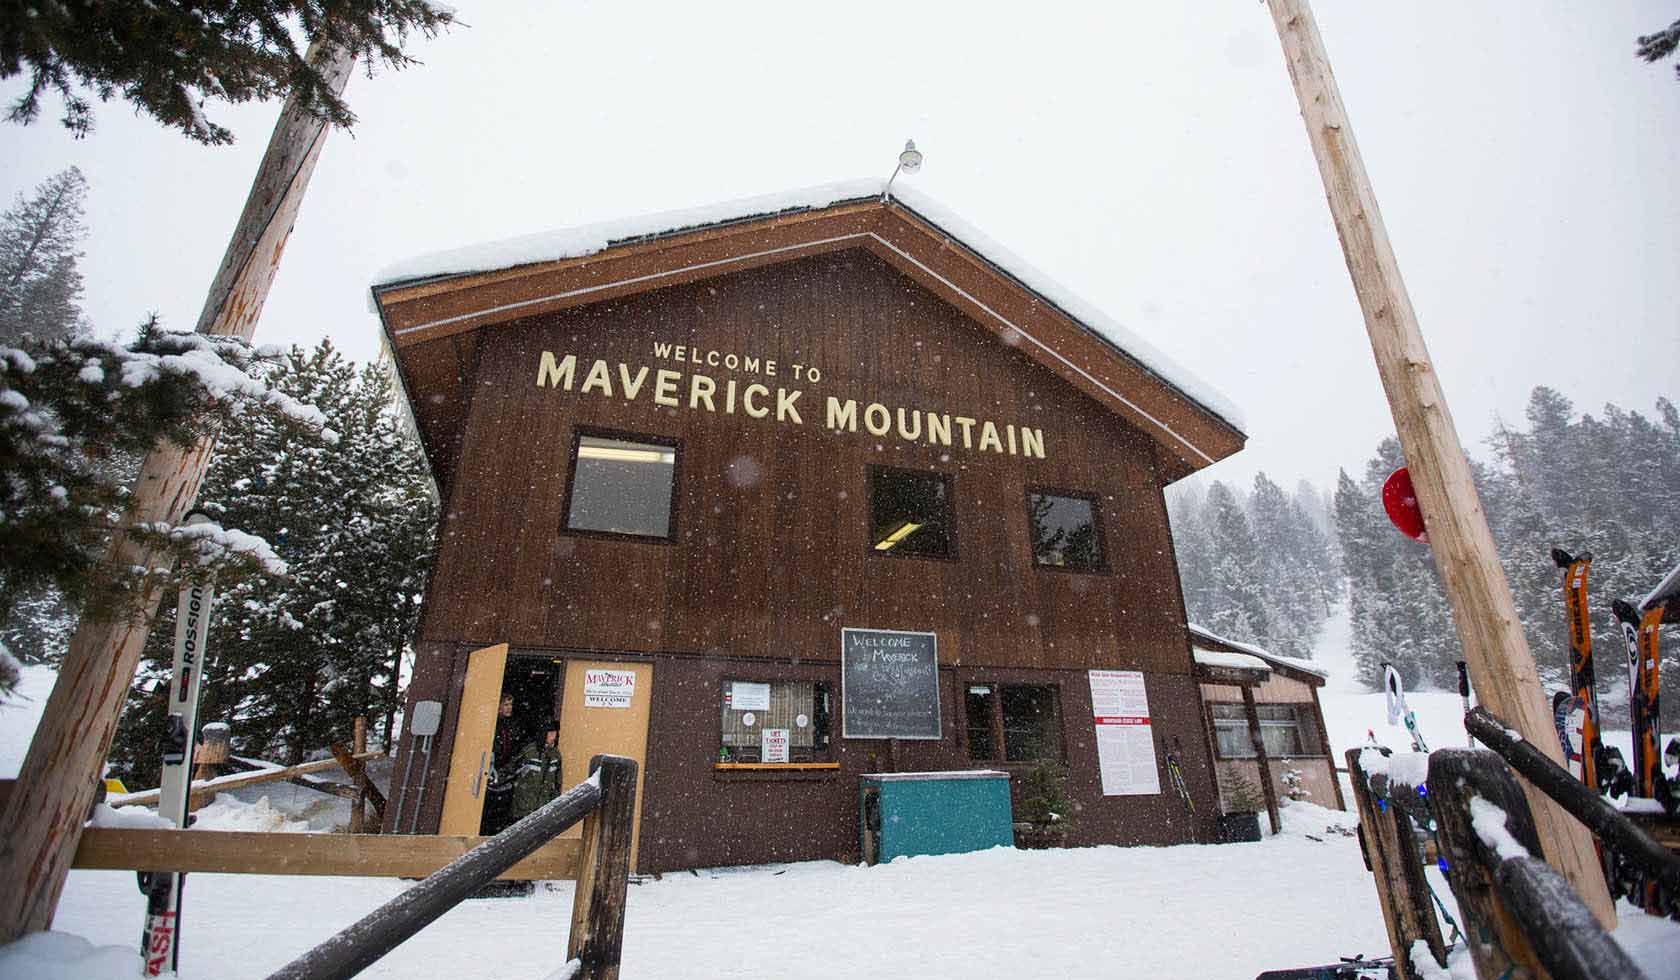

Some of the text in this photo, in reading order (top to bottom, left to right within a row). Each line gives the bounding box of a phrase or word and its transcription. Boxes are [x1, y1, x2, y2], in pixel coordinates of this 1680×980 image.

[653, 342, 821, 383] WELCOME TO
[536, 350, 1046, 459] MAVERICK MOUNTAIN
[183, 582, 204, 664] ROSSIGN
[586, 673, 633, 686] MAVERICK
